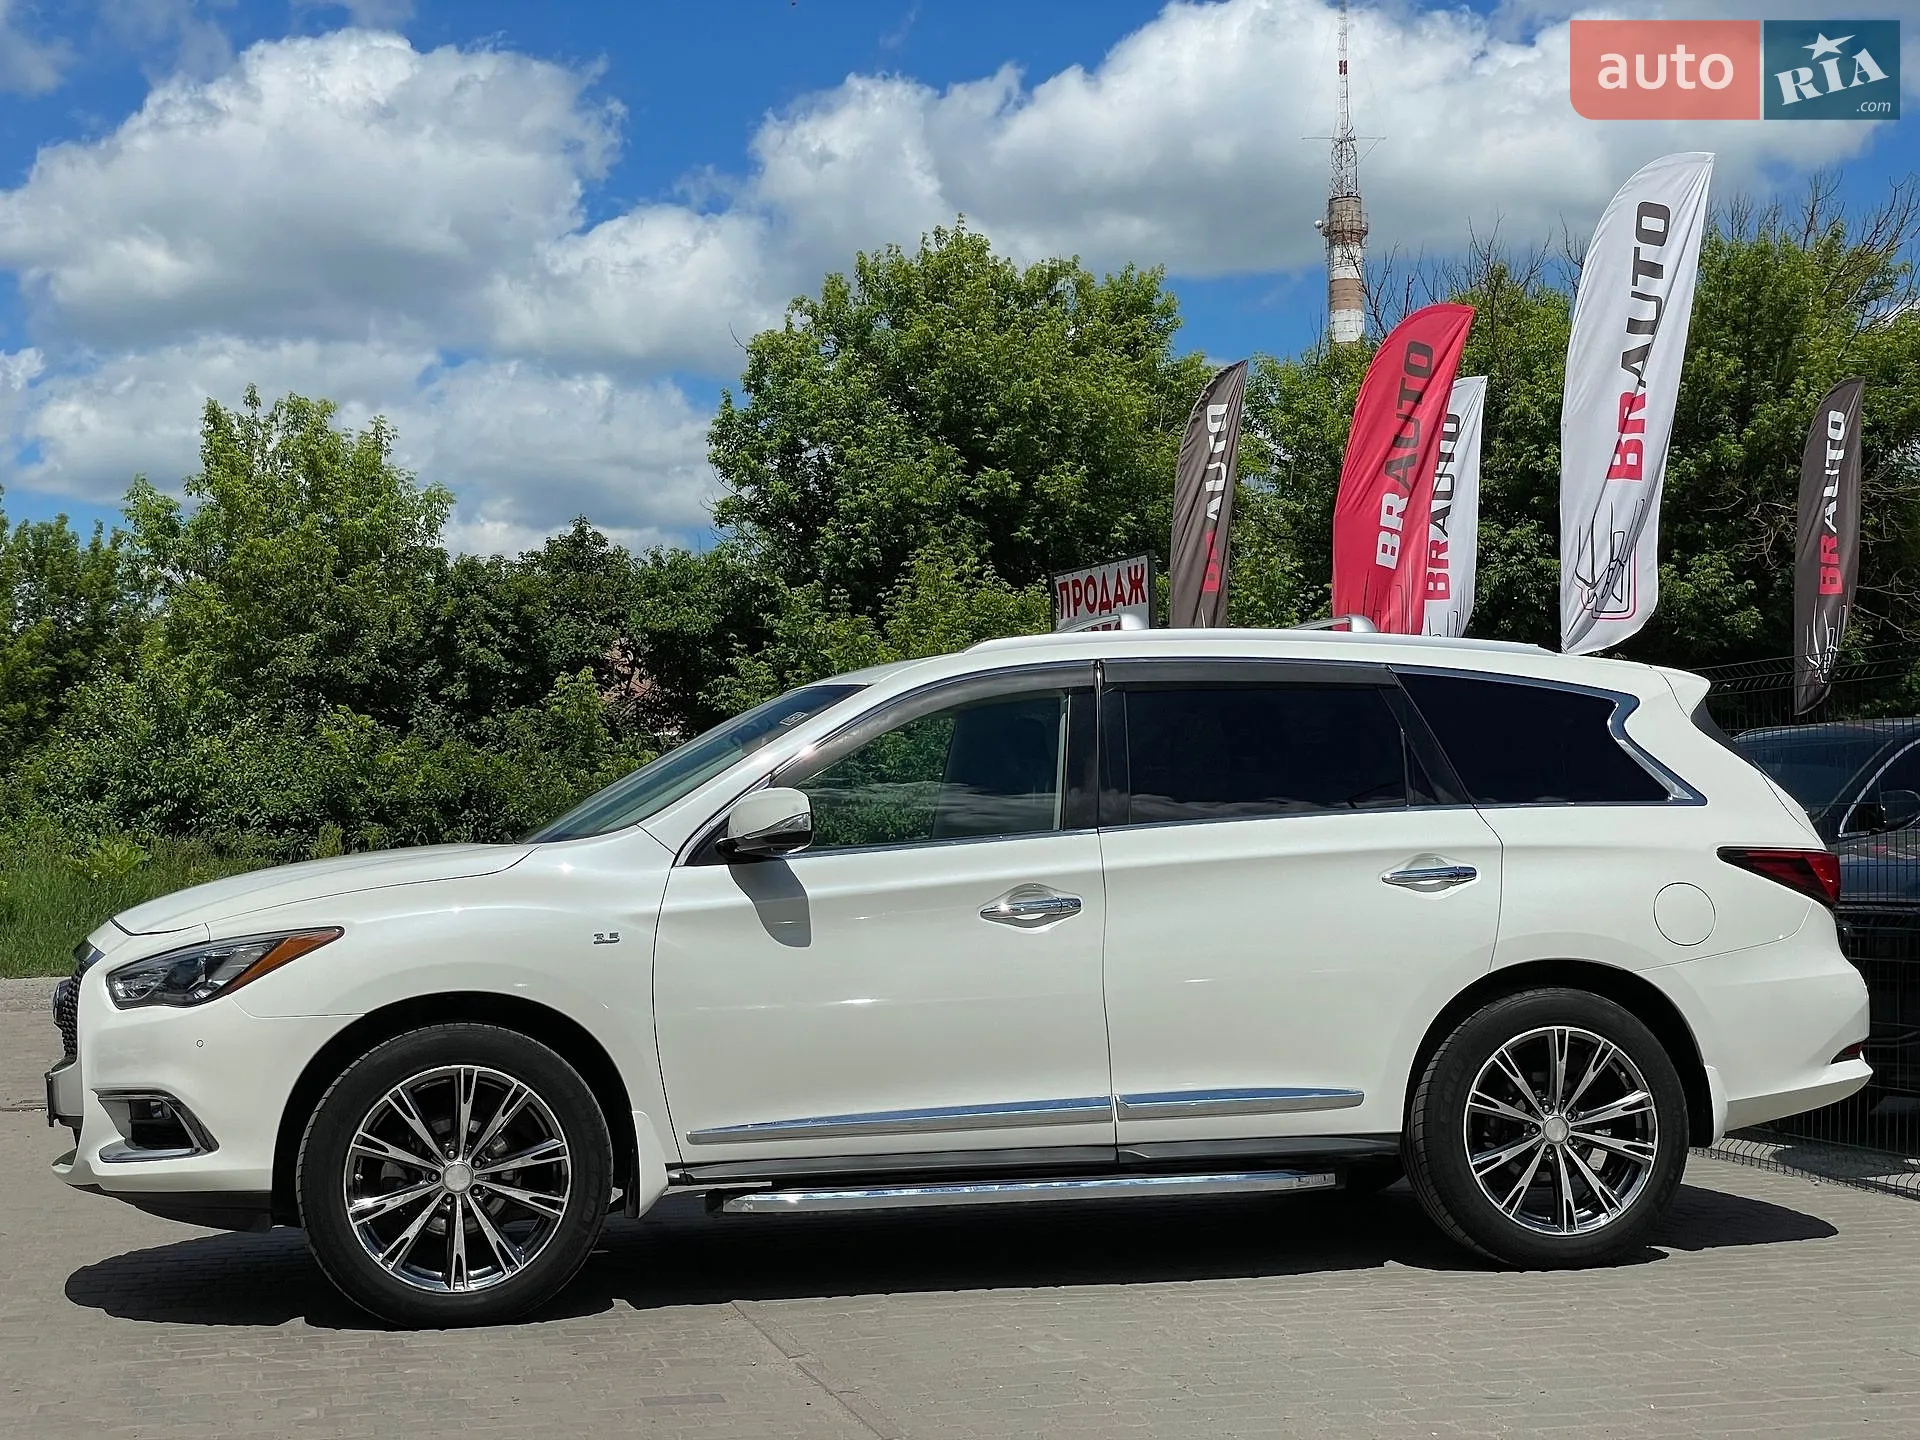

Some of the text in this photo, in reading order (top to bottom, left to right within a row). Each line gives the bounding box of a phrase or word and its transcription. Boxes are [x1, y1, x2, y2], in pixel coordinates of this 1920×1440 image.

[1606, 200, 1672, 482] BRAUTO
[1374, 340, 1435, 570] BRAUTO
[1818, 410, 1846, 595] BRAUTO
[1058, 563, 1147, 620] ПРОДАЖ
